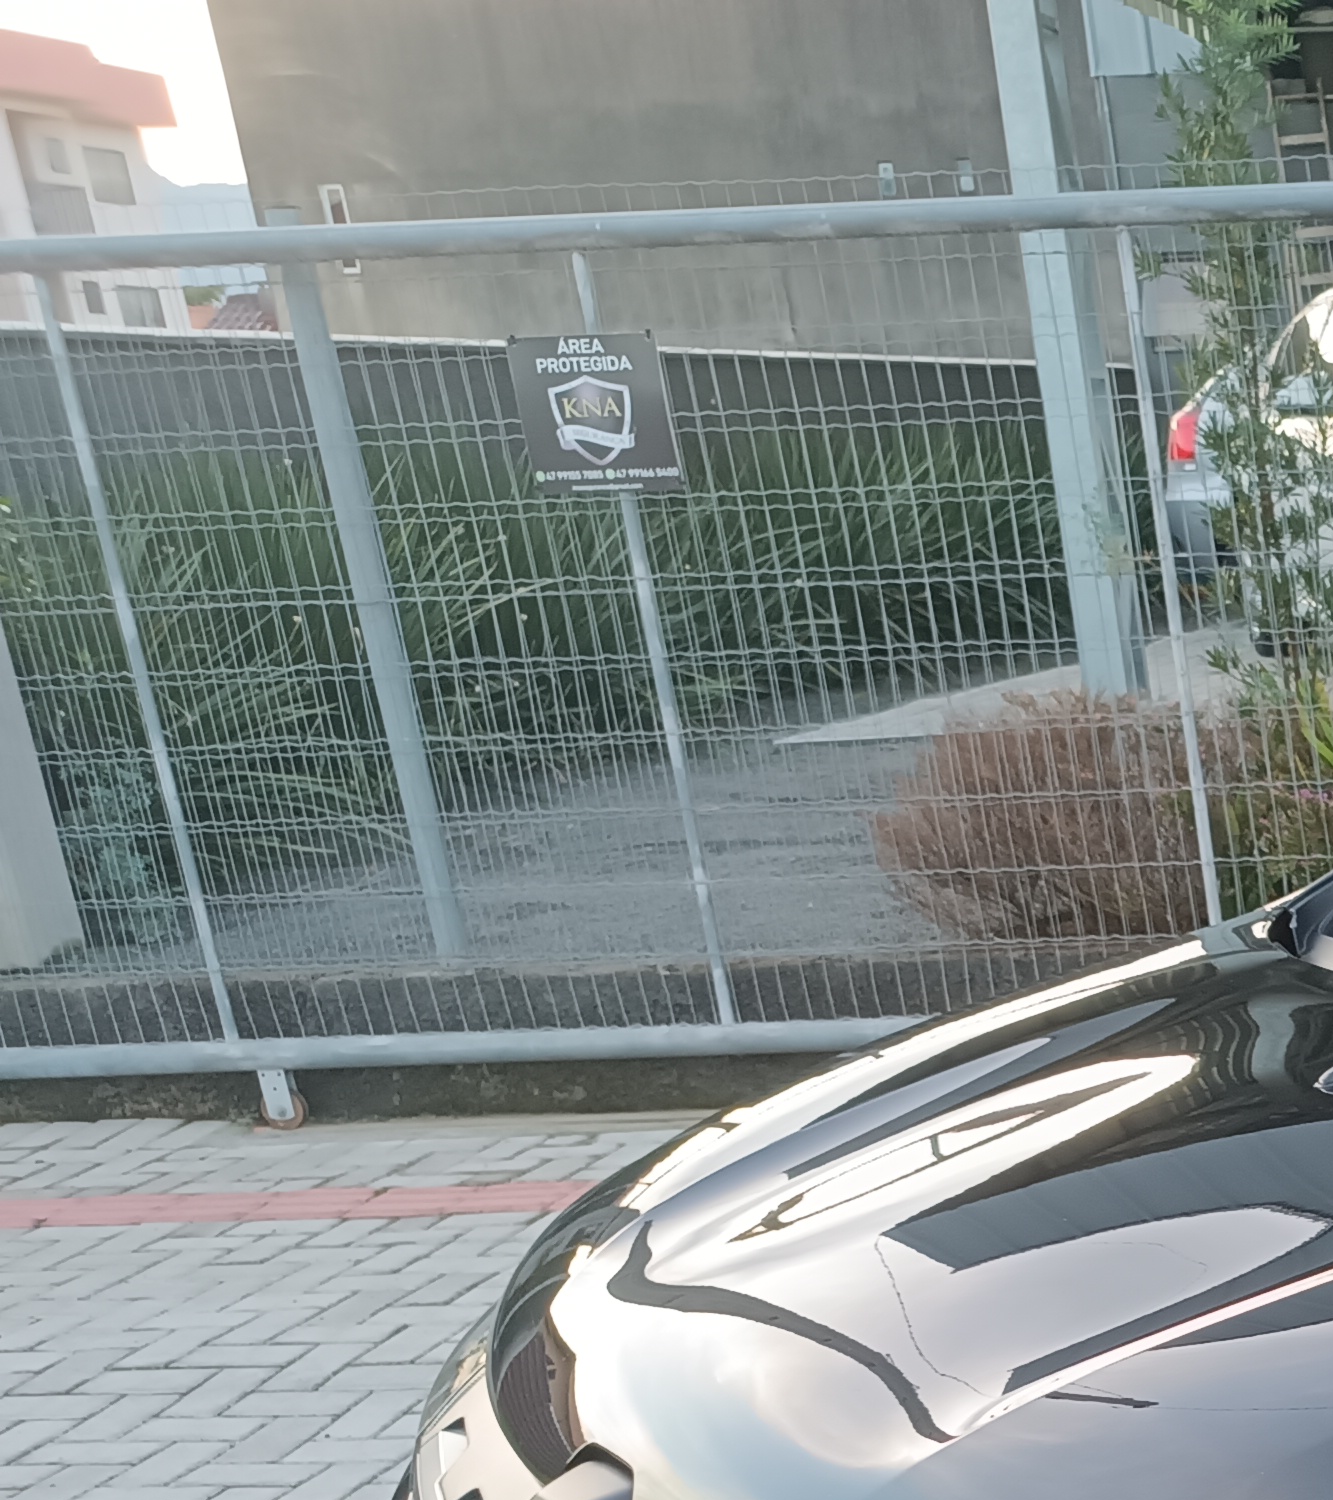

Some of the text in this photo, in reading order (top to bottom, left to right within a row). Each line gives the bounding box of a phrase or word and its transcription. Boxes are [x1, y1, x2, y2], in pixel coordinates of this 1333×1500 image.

[557, 336, 605, 355] ÁREA
[535, 355, 633, 374] PROTEGIDA
[561, 396, 622, 419] KNA
